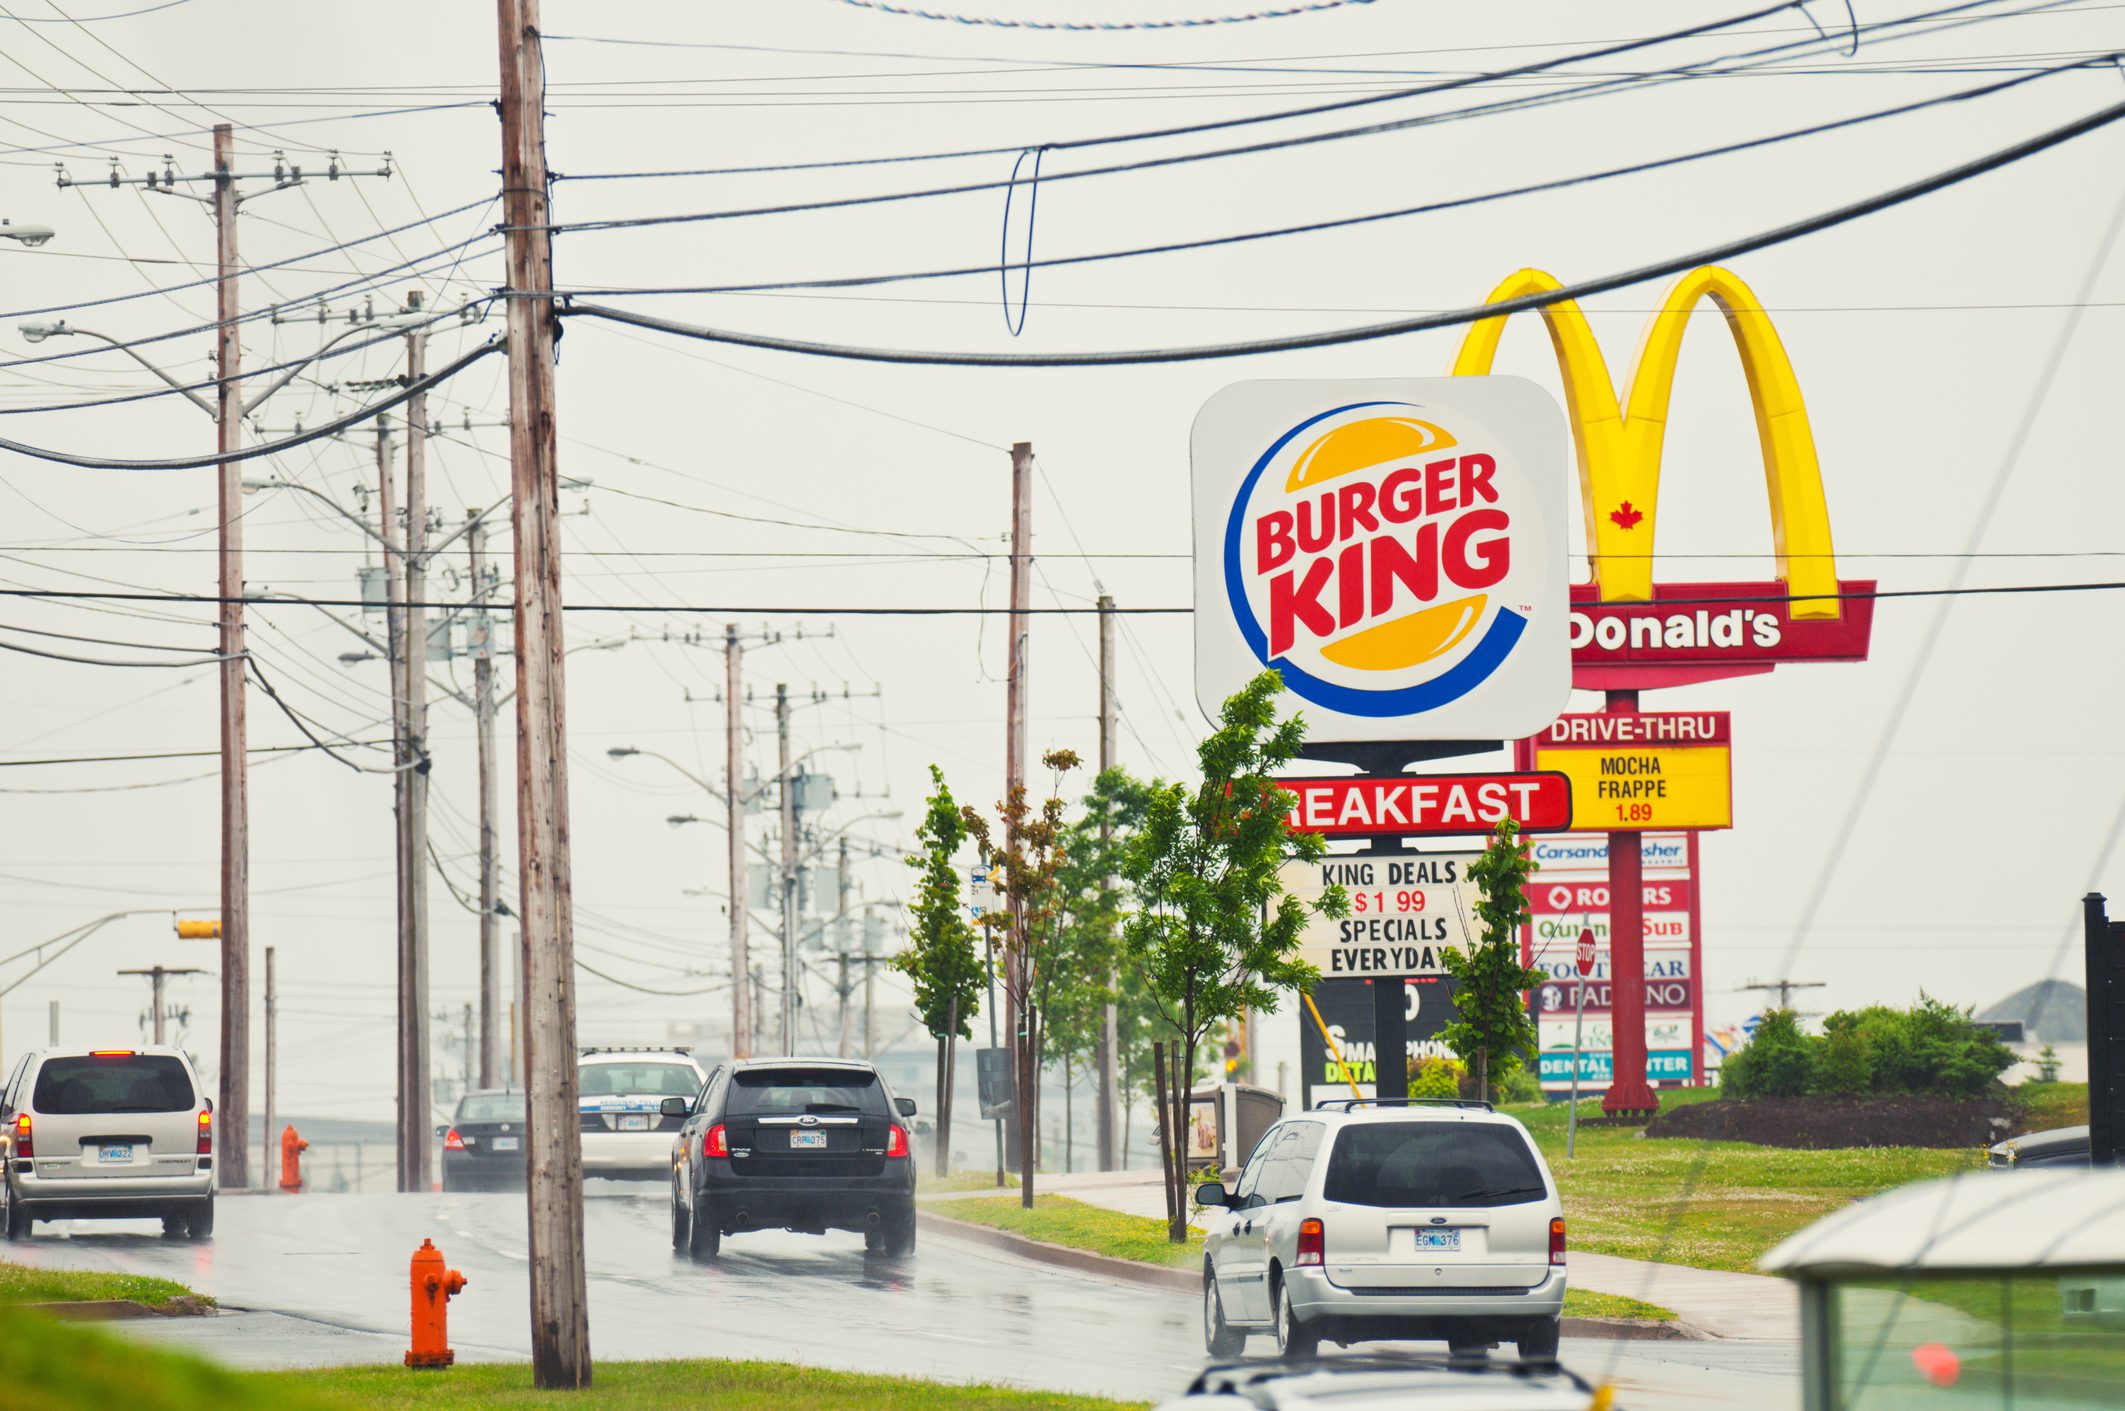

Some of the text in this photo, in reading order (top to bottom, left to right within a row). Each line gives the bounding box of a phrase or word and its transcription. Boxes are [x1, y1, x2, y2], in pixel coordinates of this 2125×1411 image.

[1256, 453, 1499, 576] BURGER
[1270, 508, 1510, 657] KING
[1551, 716, 1715, 742] DRIVE-THRU
[1601, 756, 1661, 775] MOCHA
[1599, 780, 1666, 799] FRAPPE
[1279, 782, 1540, 827] REAKFAST
[1616, 803, 1652, 822] 1.89
[1323, 861, 1457, 886] KING DEALS
[1577, 887, 1672, 906] RORS
[1340, 917, 1447, 943] SPECIALS
[1577, 943, 1596, 962] STOP
[1569, 984, 1686, 1007] PADNO
